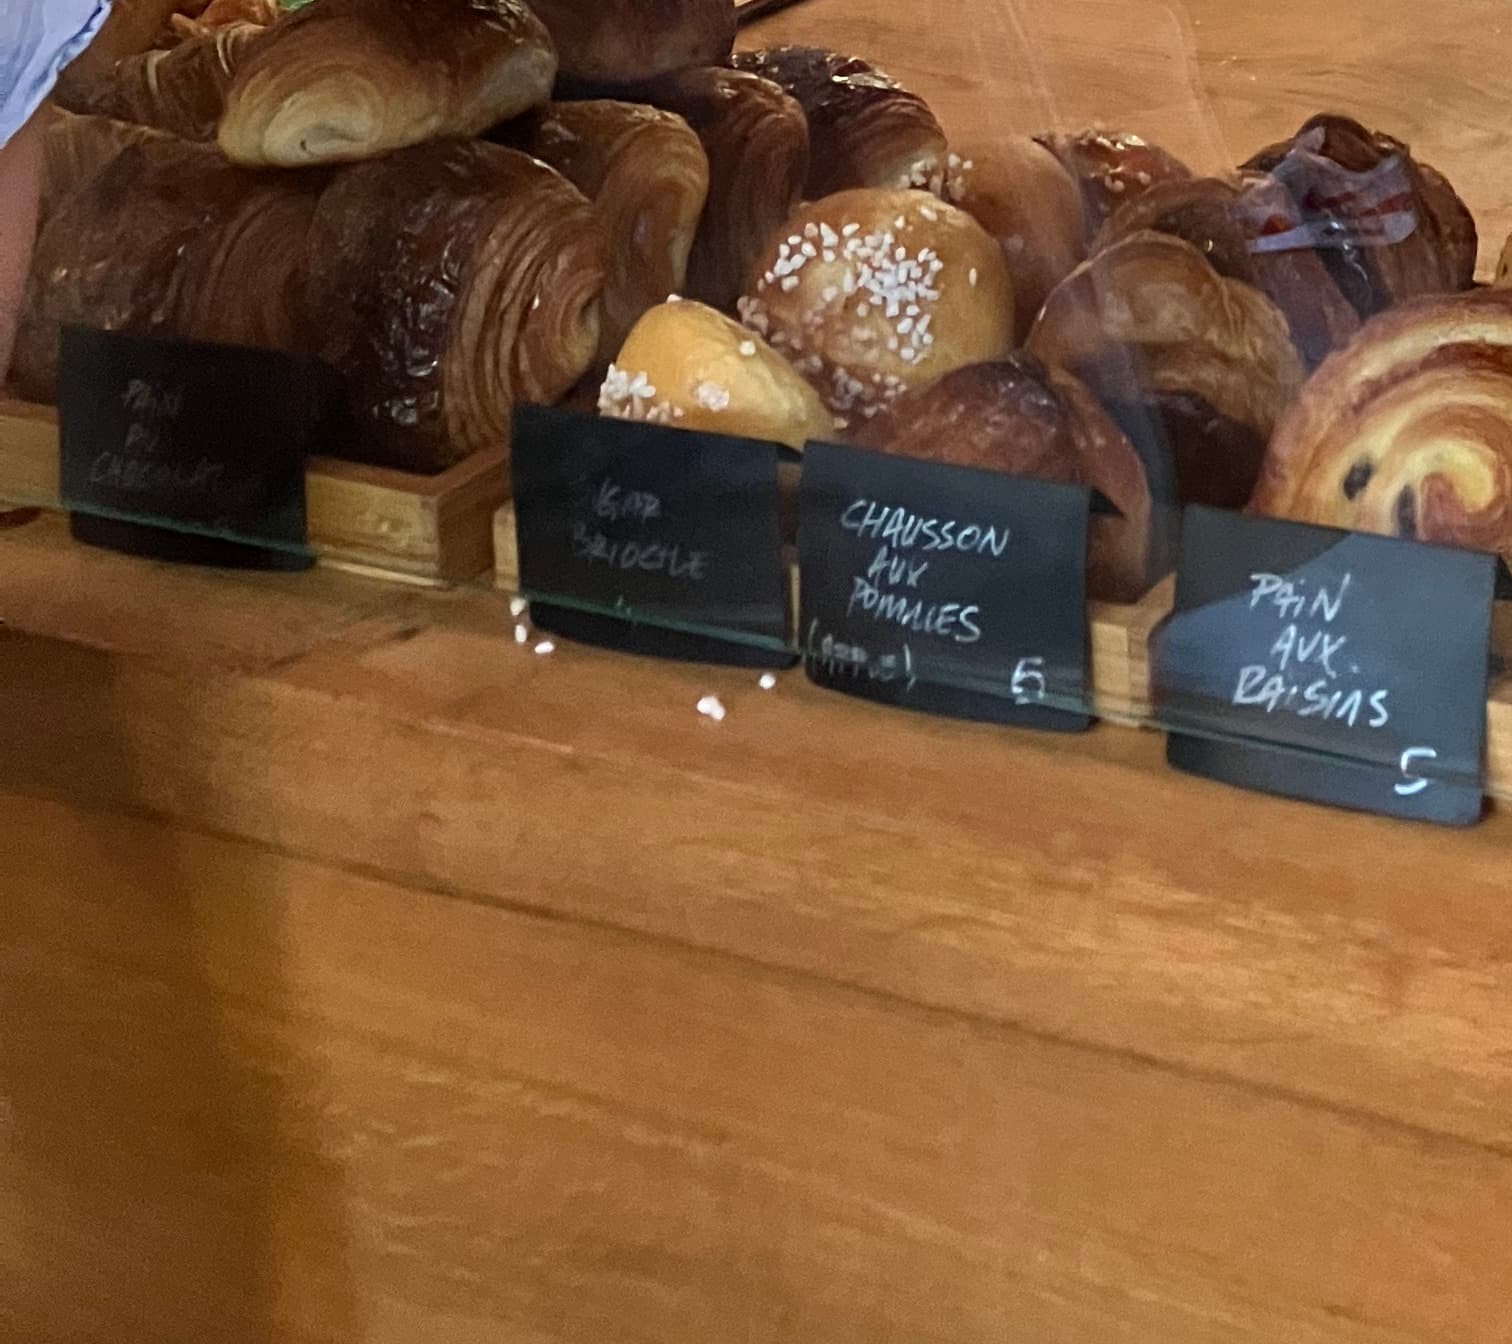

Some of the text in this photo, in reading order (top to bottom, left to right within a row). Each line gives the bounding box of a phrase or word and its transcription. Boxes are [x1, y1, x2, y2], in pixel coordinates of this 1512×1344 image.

[841, 499, 1010, 556] CHAUSSON
[867, 545, 928, 588] AUX
[1250, 572, 1351, 622] PAIN
[1394, 747, 1437, 796] 5
